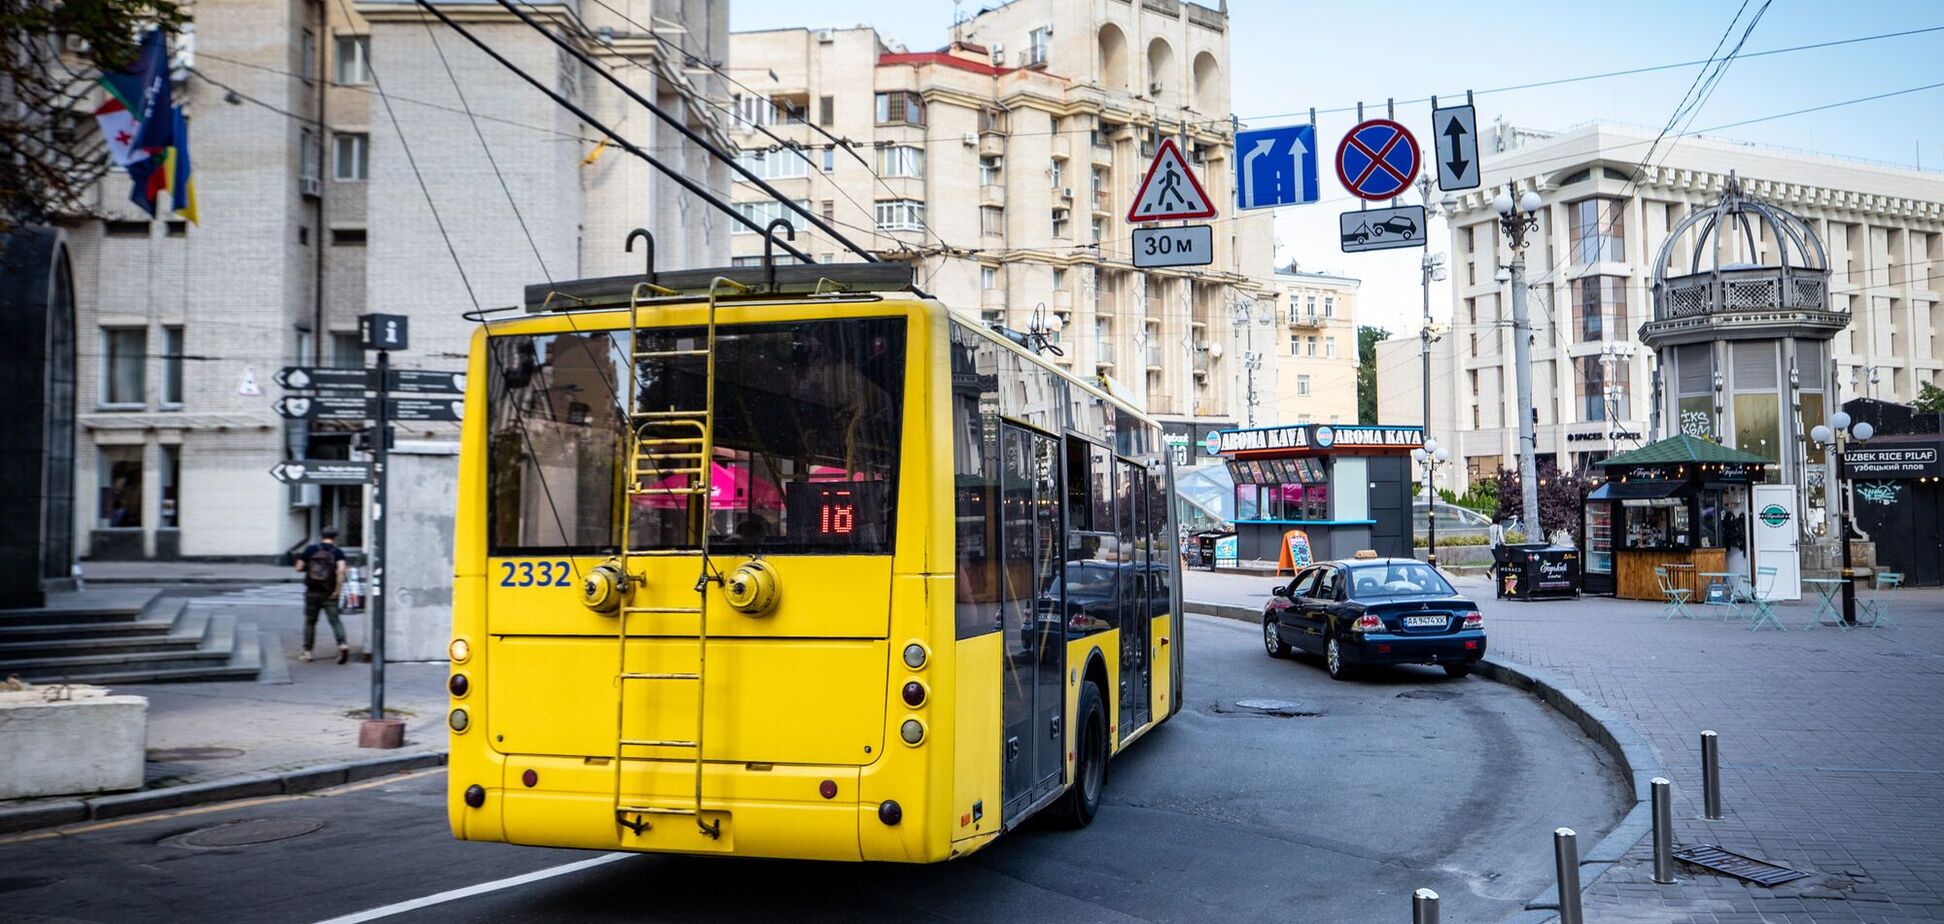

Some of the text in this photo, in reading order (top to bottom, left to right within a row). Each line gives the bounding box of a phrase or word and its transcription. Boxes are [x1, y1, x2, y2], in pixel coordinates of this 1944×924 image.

[1144, 235, 1172, 256] 30
[1220, 427, 1307, 451] AROMA KAVA
[1333, 429, 1422, 445] AROMA KAVA
[1844, 451, 1933, 461] UZBEK RICE PILAF
[1854, 464, 1900, 472] узбецький
[501, 561, 571, 587] 2332
